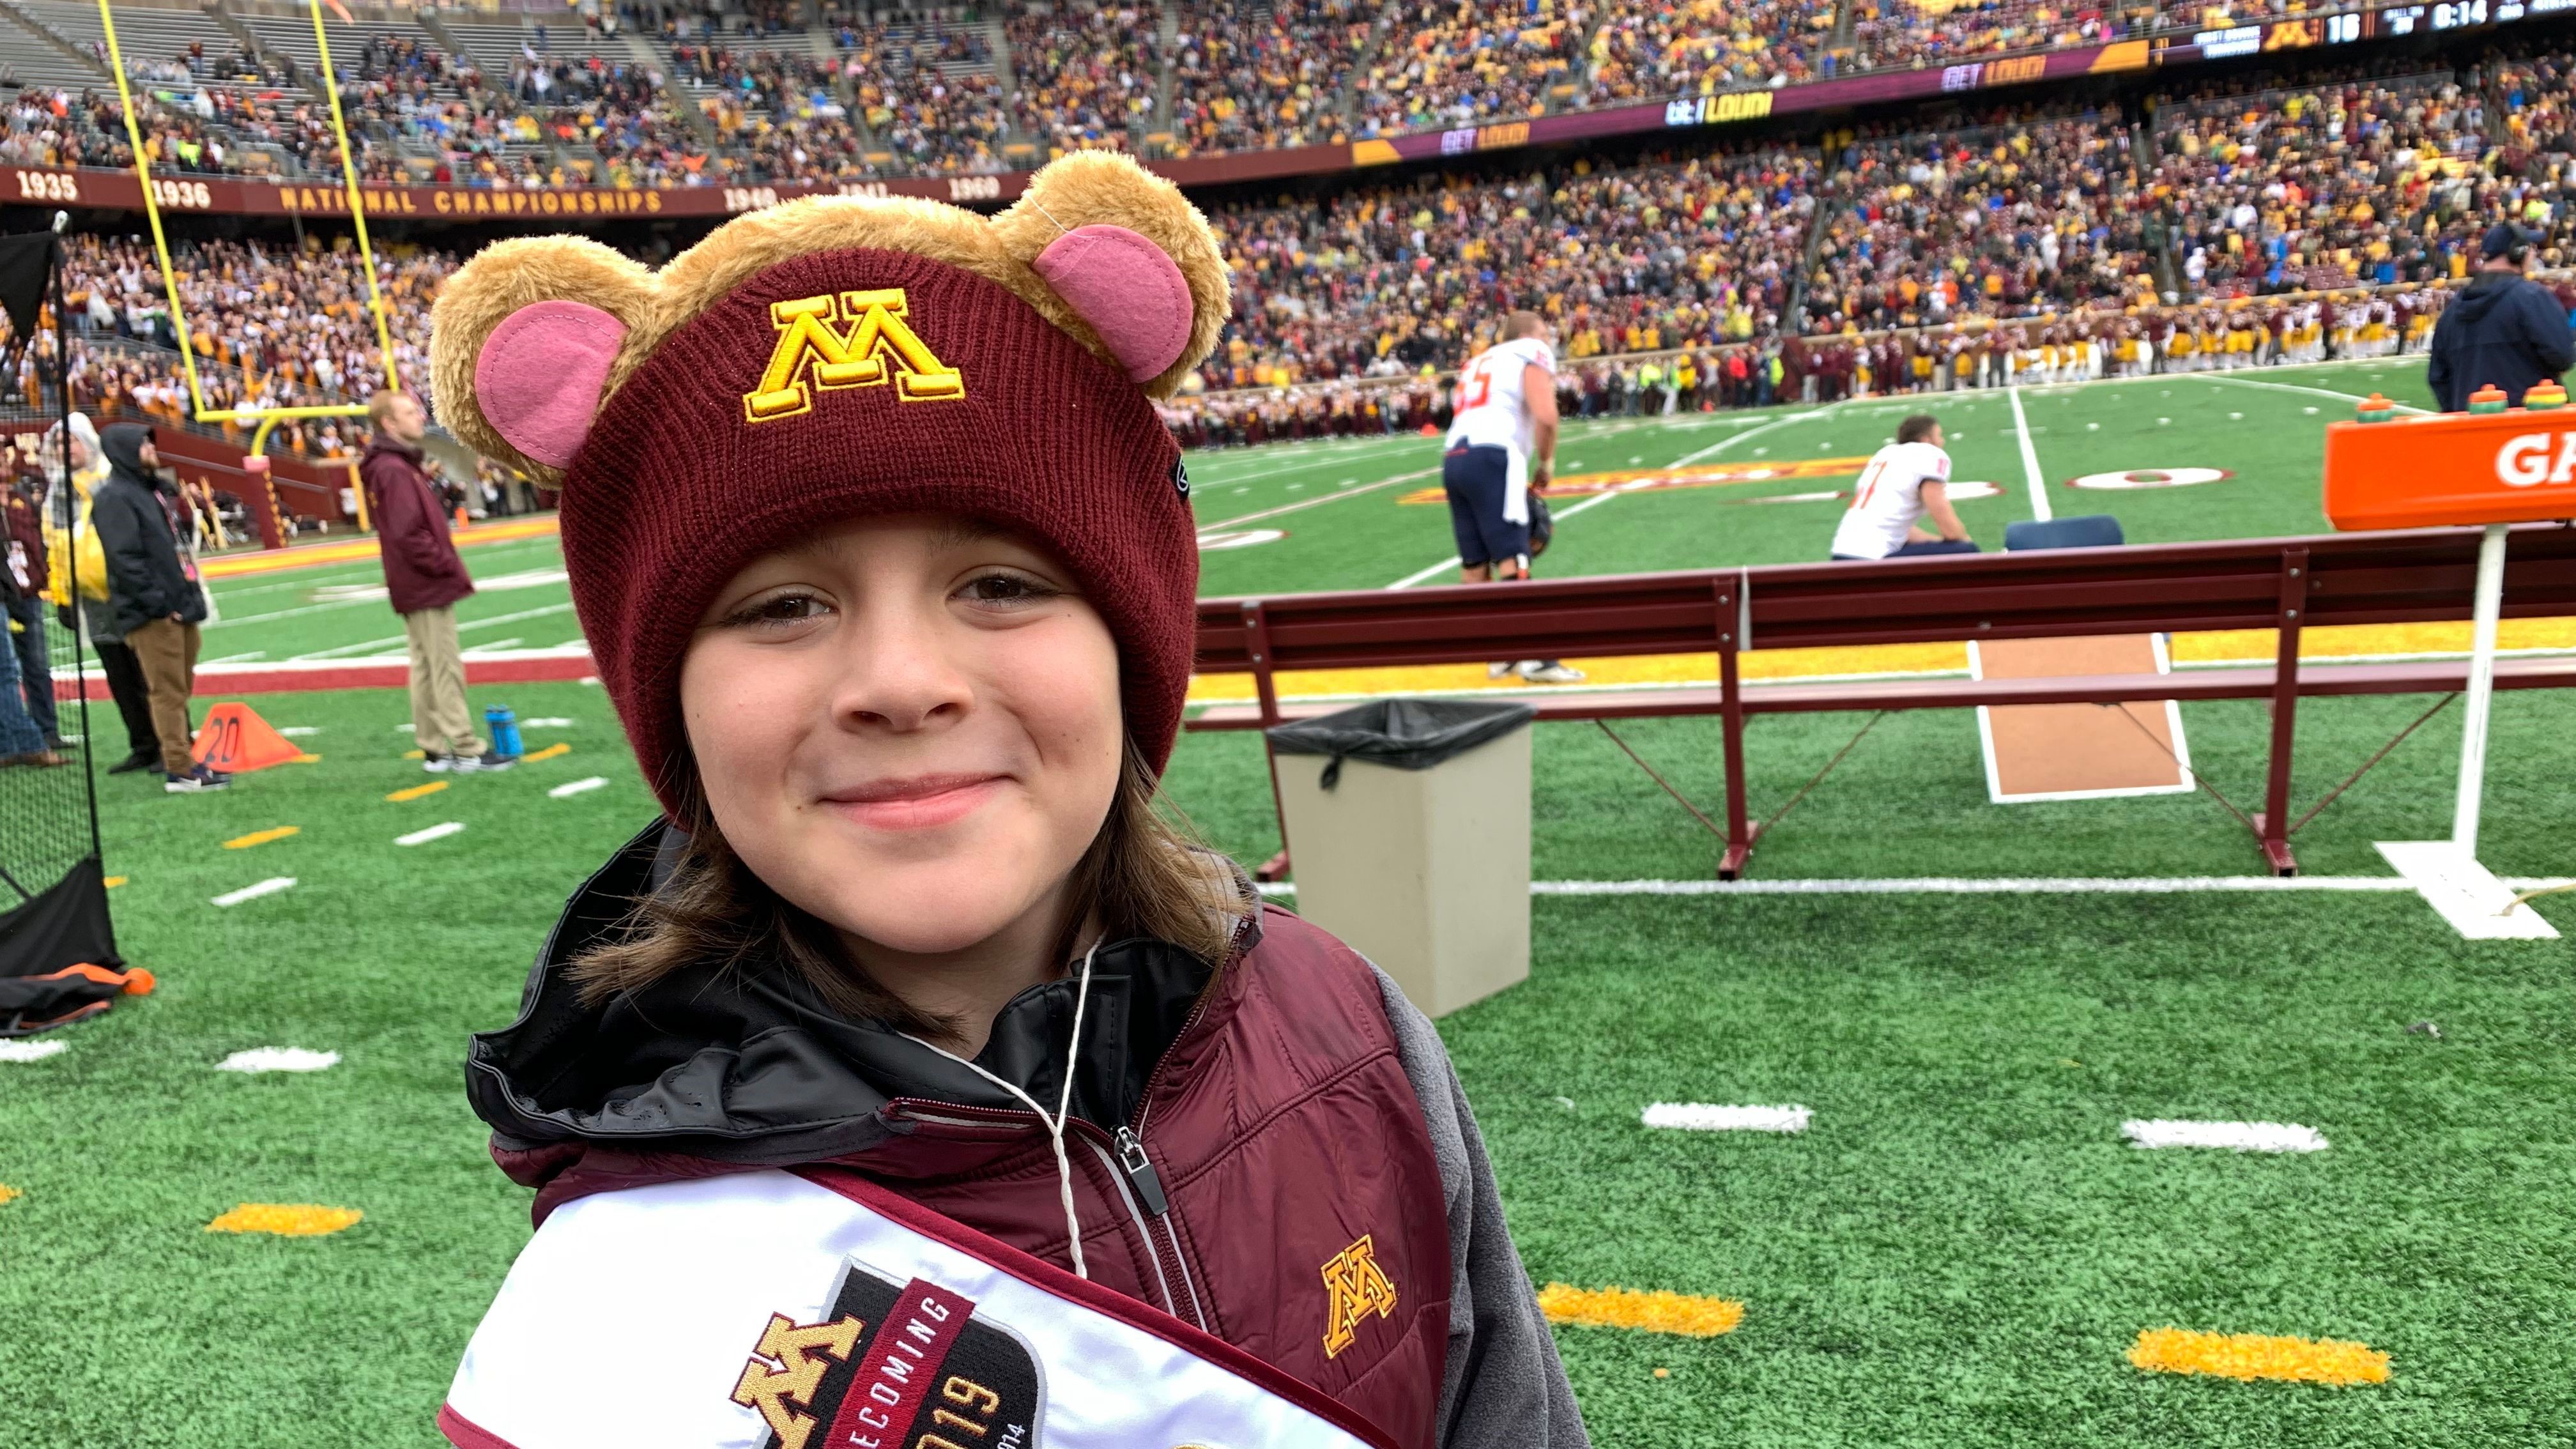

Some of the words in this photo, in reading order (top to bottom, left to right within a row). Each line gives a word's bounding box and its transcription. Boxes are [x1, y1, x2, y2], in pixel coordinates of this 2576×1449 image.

[2327, 13, 2361, 44] 16
[1705, 92, 1774, 123] LOUD!
[16, 170, 79, 201] 1935
[151, 180, 211, 209] 1936
[434, 190, 662, 214] CHAMPIONSHIPS
[949, 176, 1000, 201] 1960
[742, 288, 965, 423] M
[204, 716, 240, 763] 20
[1321, 1234, 1397, 1360] M
